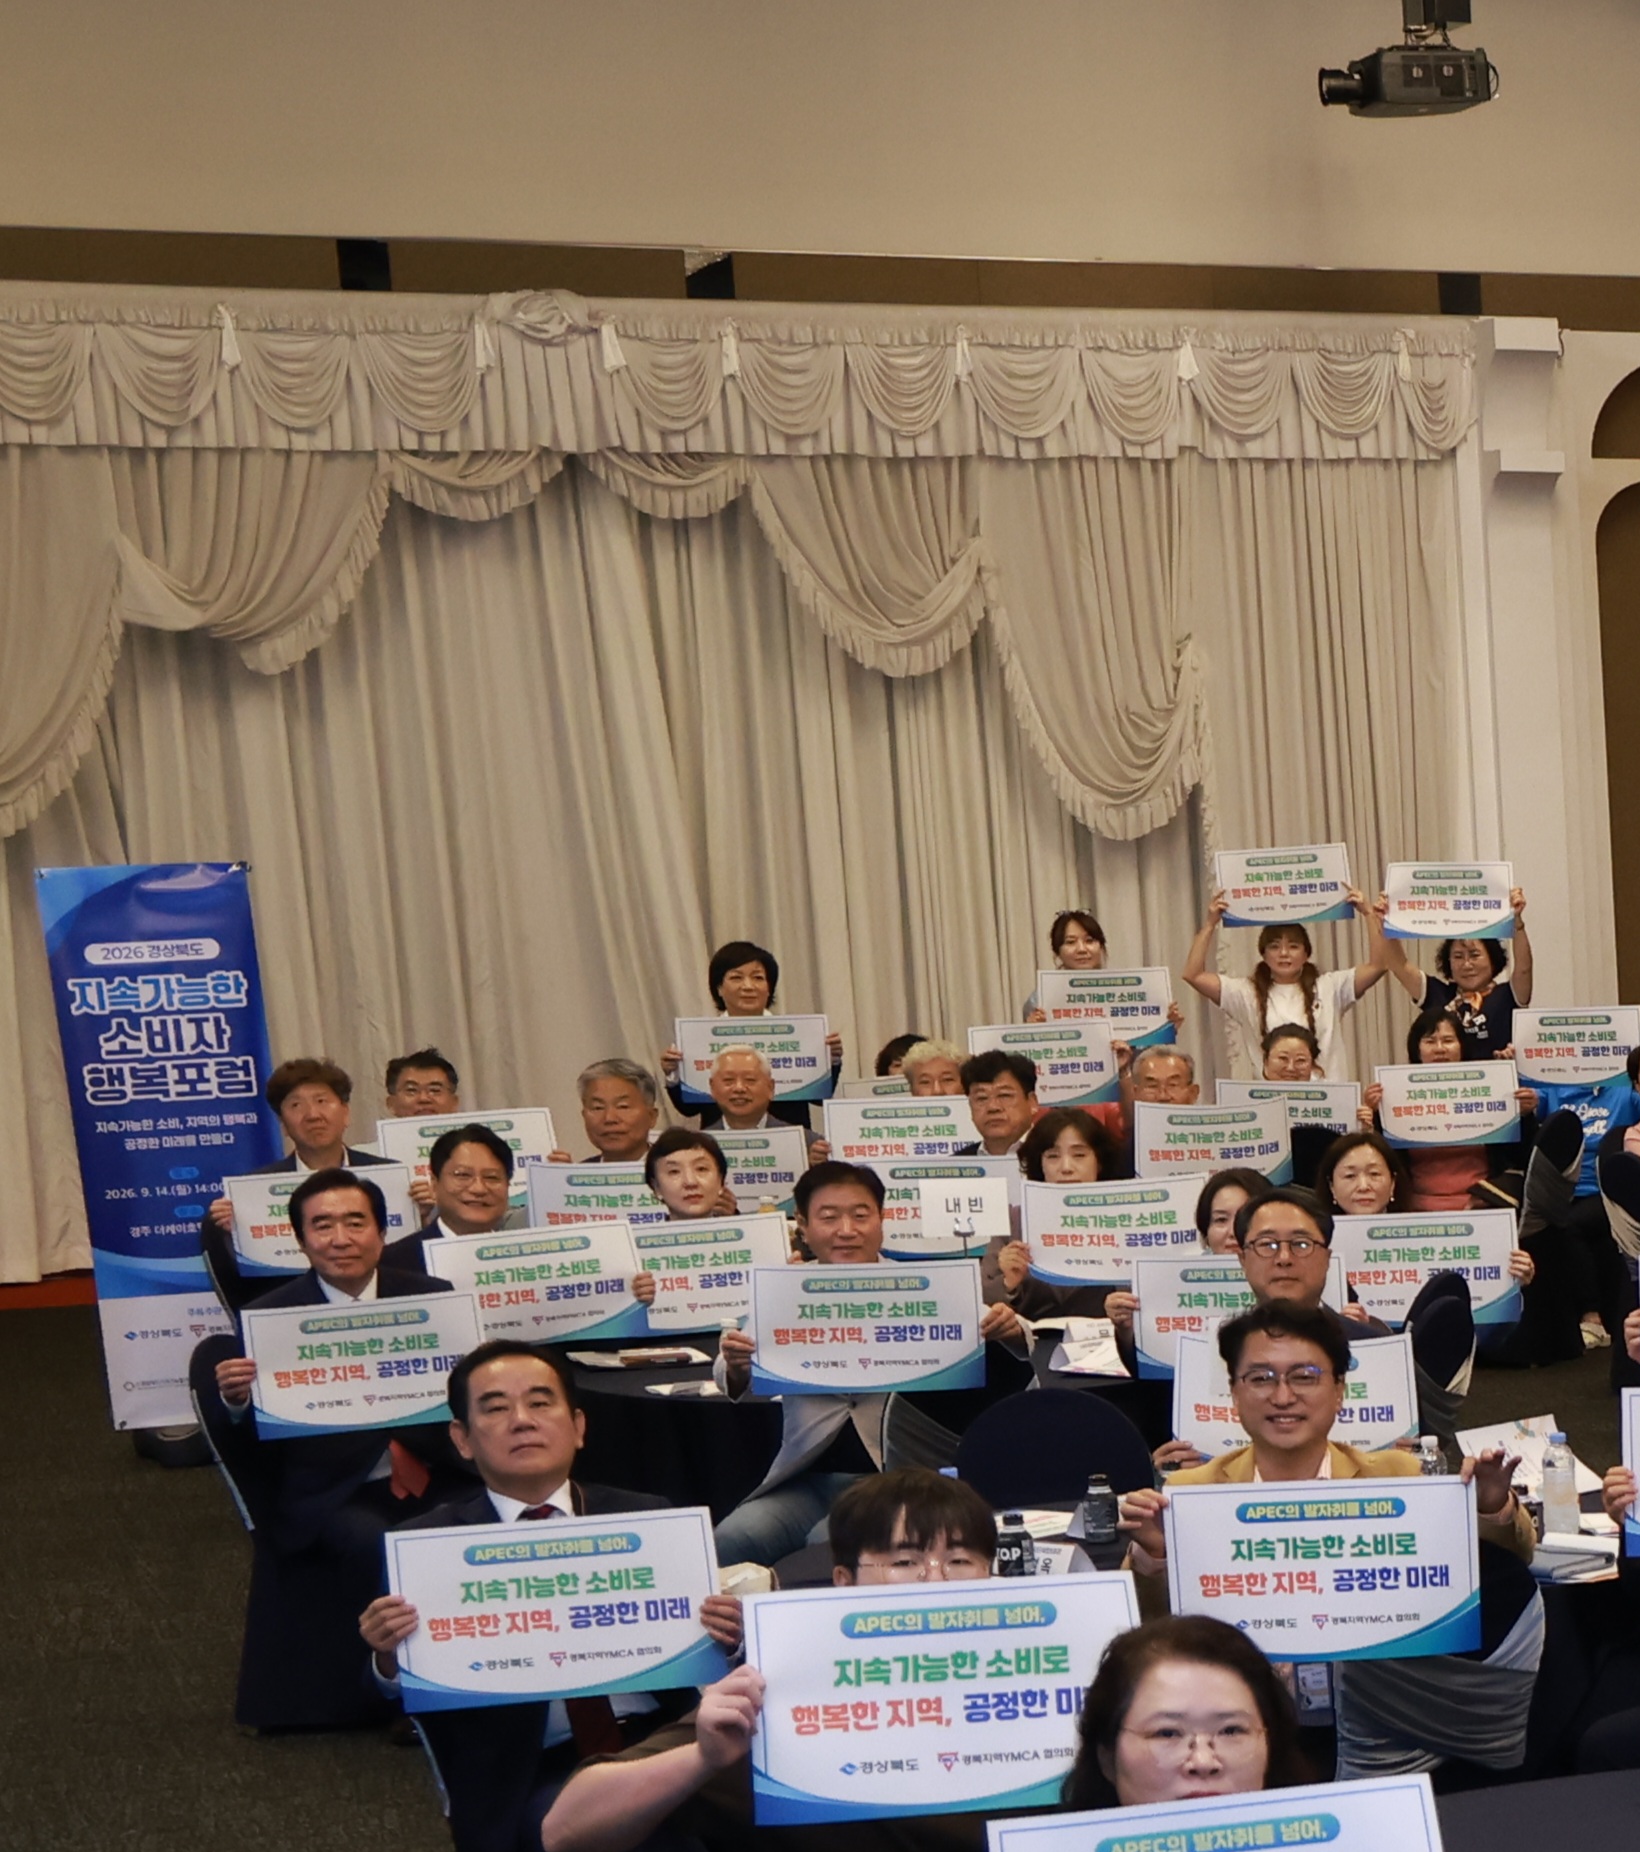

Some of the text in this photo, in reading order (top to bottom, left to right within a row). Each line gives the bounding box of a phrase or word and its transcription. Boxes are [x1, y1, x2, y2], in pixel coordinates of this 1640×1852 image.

[100, 942, 205, 960] 2026 경상북도
[67, 970, 248, 1016] 지속가능한
[98, 1012, 232, 1060] 소비자
[82, 1055, 258, 1106] 행복포럼
[797, 1300, 938, 1320] 지속가능한 소비로
[772, 1323, 962, 1345] 행복한 지역, 공정한 미래
[1192, 1823, 1274, 1852] 발자취를
[1278, 1818, 1325, 1842] 넘어,
